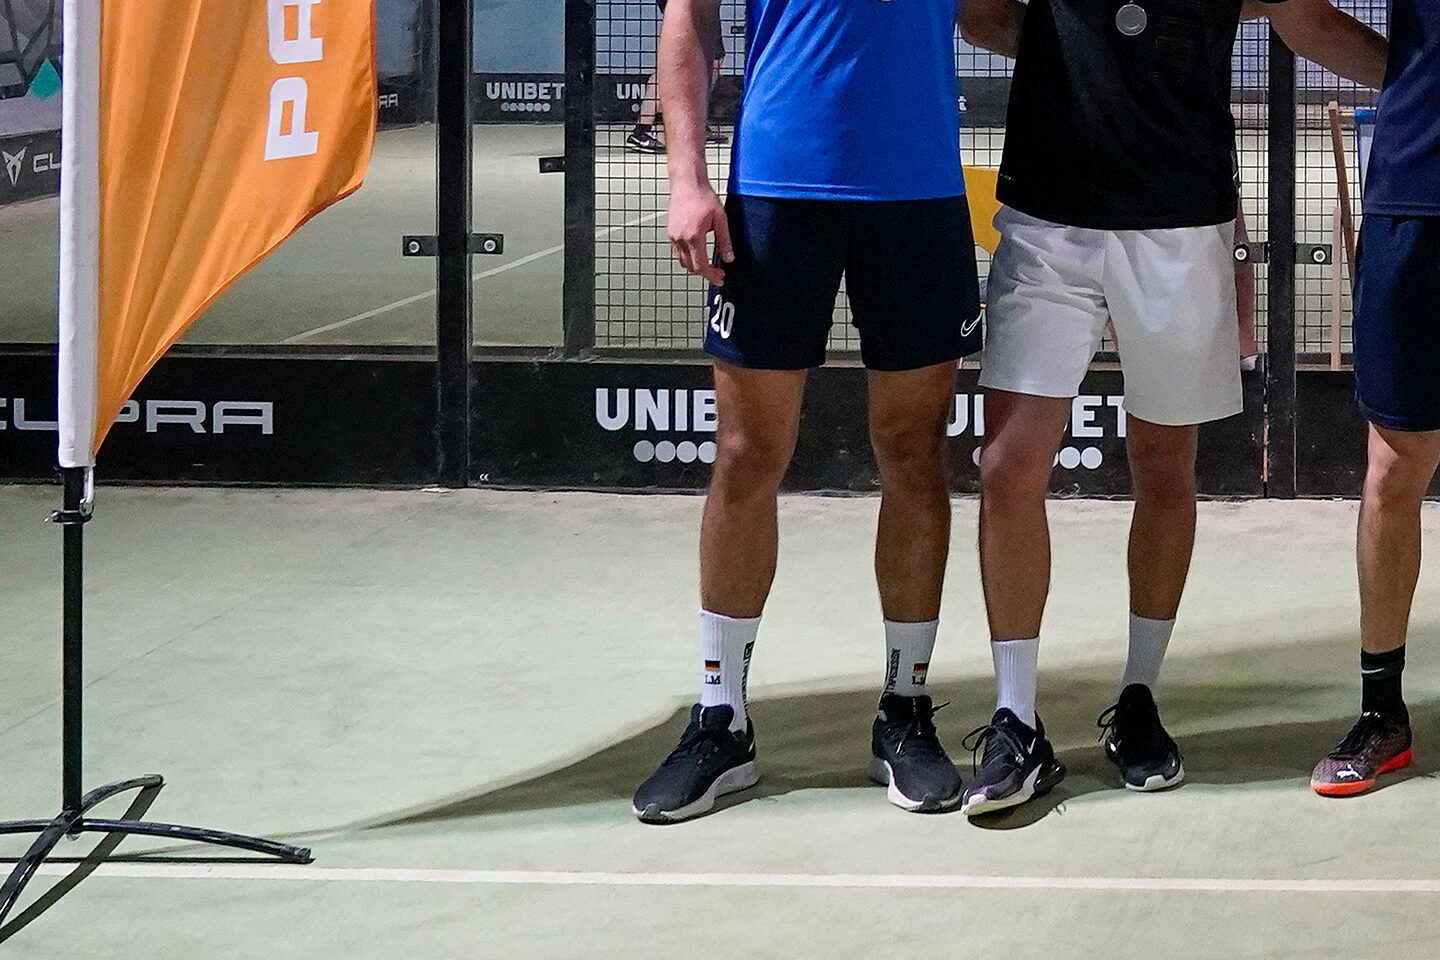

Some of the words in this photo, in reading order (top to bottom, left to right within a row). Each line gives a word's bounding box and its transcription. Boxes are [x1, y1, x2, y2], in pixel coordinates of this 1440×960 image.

[486, 82, 566, 100] UNIBET
[711, 293, 736, 340] 20
[595, 388, 709, 432] UNIB
